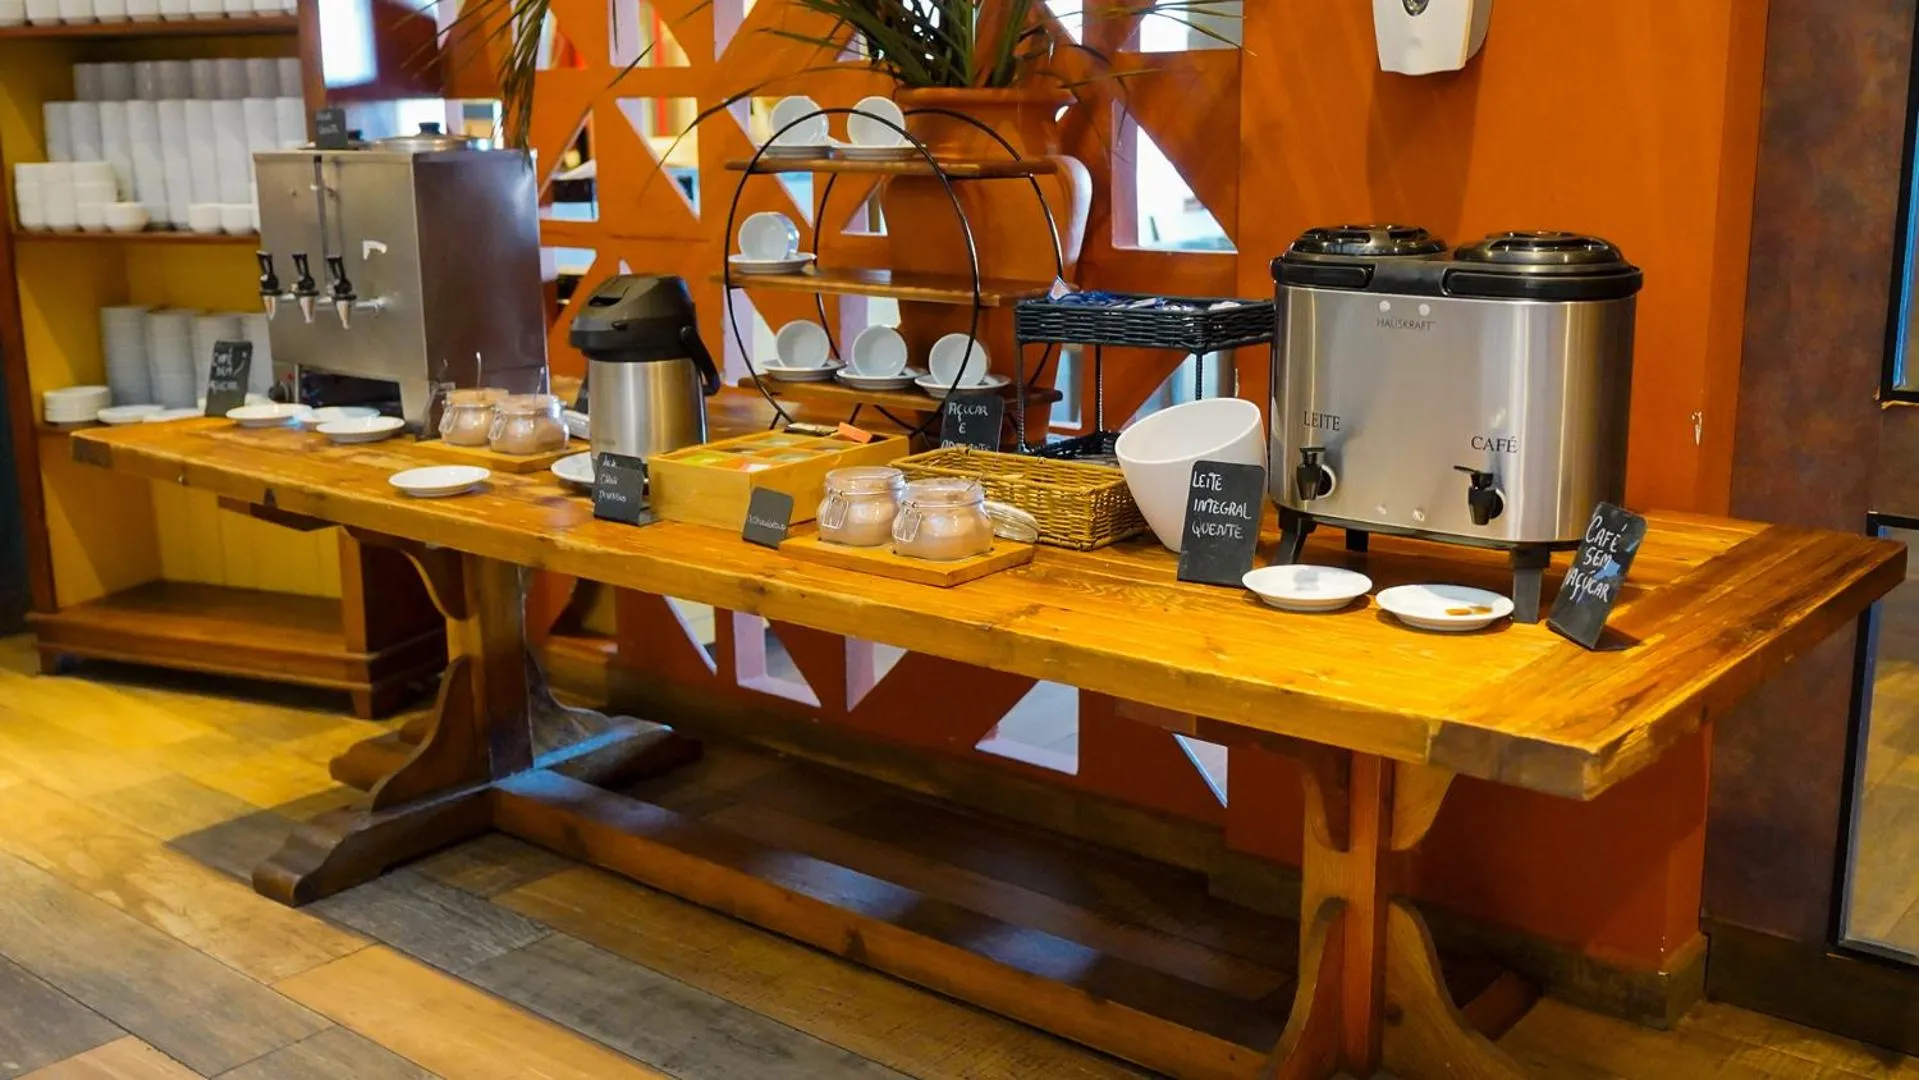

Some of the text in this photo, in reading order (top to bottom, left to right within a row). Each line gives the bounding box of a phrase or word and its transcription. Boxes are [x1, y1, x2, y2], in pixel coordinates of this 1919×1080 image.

[958, 422, 967, 434] E
[1303, 410, 1341, 432] LEITE
[1470, 435, 1519, 454] CAFÉ
[1192, 498, 1253, 520] INTEGRAL
[1191, 521, 1244, 540] QUENTE
[1582, 546, 1613, 567] SEM
[1565, 567, 1611, 604] AÇÚCAR
